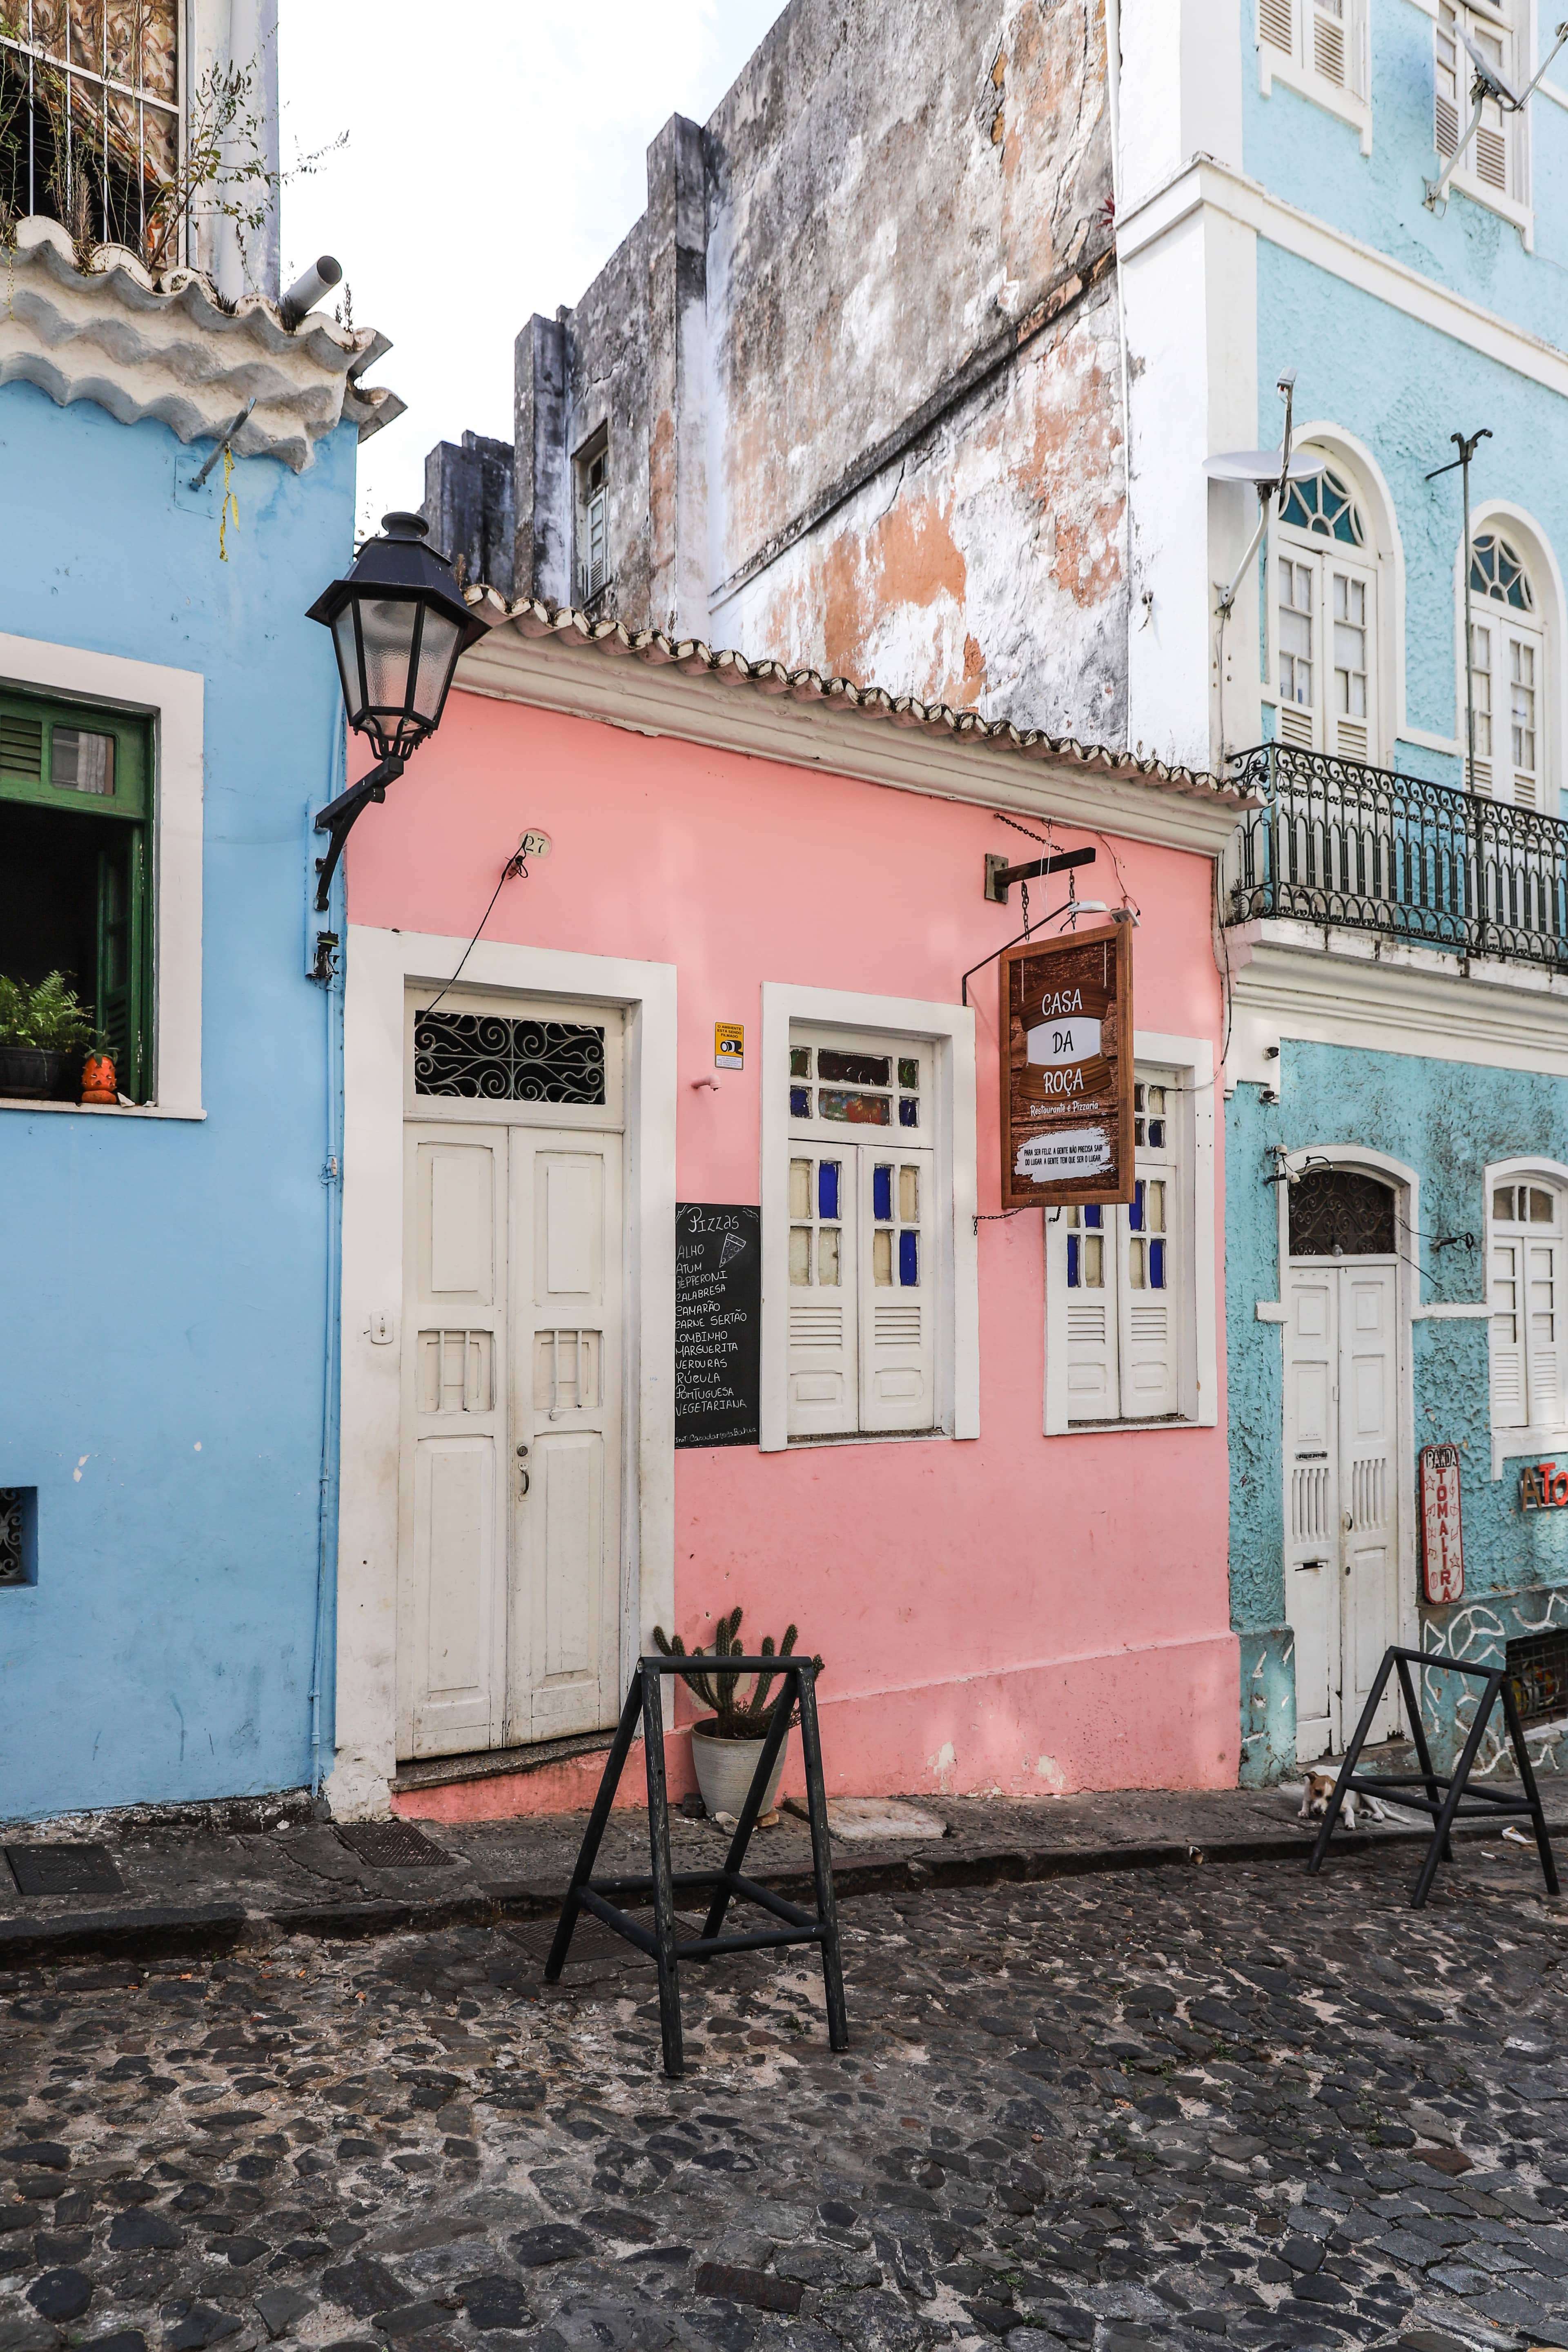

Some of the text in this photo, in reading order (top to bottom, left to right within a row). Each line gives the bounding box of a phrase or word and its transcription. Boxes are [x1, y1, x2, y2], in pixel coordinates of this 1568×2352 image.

[526, 836, 545, 853] 27
[1042, 988, 1082, 1016] CASA
[1052, 1030, 1074, 1054] DA
[1043, 1068, 1084, 1097] ROÇA
[1030, 1102, 1065, 1116] Restaurante
[1072, 1100, 1098, 1112] Pizzaria
[676, 1244, 704, 1261] ALHO
[676, 1262, 702, 1275] ATUM
[676, 1271, 728, 1290] PEPPERONI
[676, 1284, 726, 1302] CALABRESA
[675, 1300, 720, 1316] CAMARÃO
[675, 1309, 747, 1329] CARNE SERTÃO
[675, 1330, 728, 1343] LOMBINHO
[675, 1343, 738, 1357] MARGUERITA
[675, 1359, 727, 1369] VERDURAS
[675, 1399, 747, 1416] VEGETARIANA
[1426, 1448, 1457, 1469] BANDA
[1436, 1468, 1451, 1601] TOMALIRA
